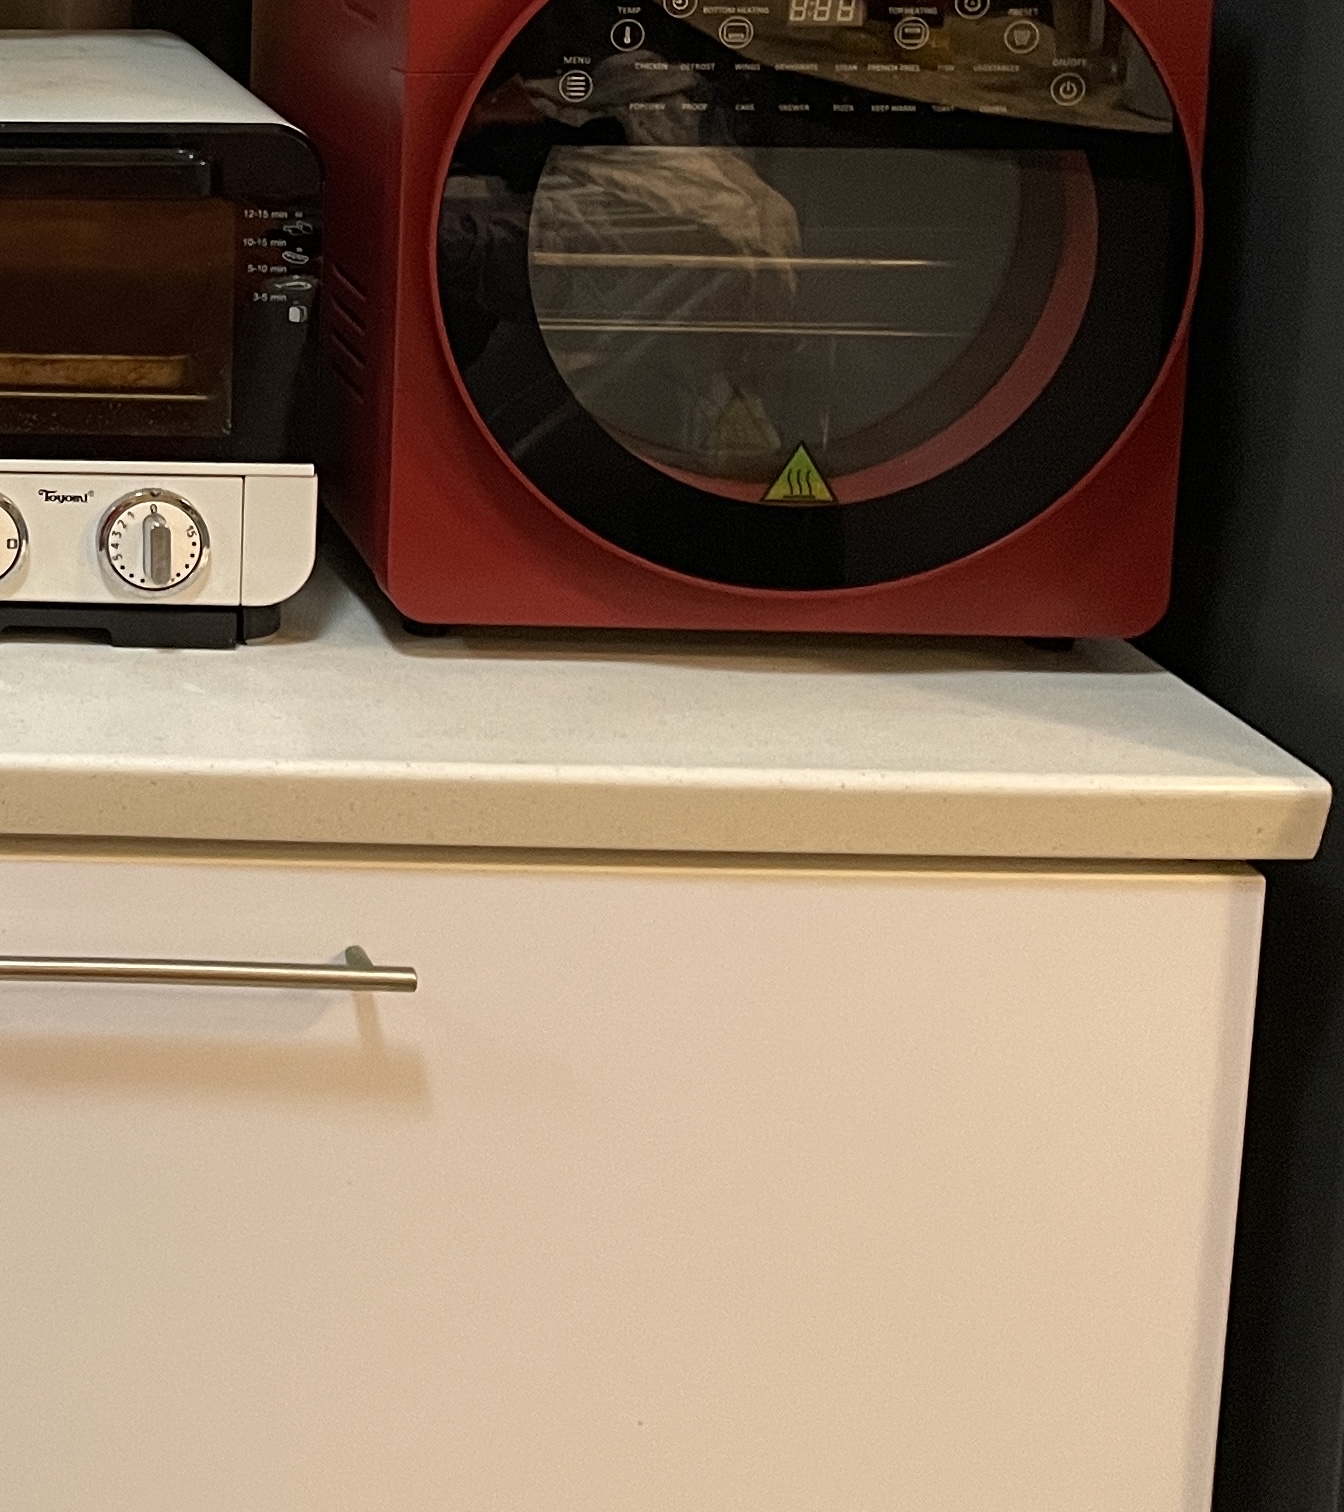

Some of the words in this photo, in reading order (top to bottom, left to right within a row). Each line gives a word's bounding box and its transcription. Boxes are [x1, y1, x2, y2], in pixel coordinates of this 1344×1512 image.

[617, 6, 641, 14] TEMP
[563, 56, 591, 65] MENU
[38, 489, 89, 503] Toyomi
[112, 530, 122, 538] 3
[186, 525, 198, 538] 15
[111, 542, 120, 550] 4
[112, 553, 123, 561] 5
